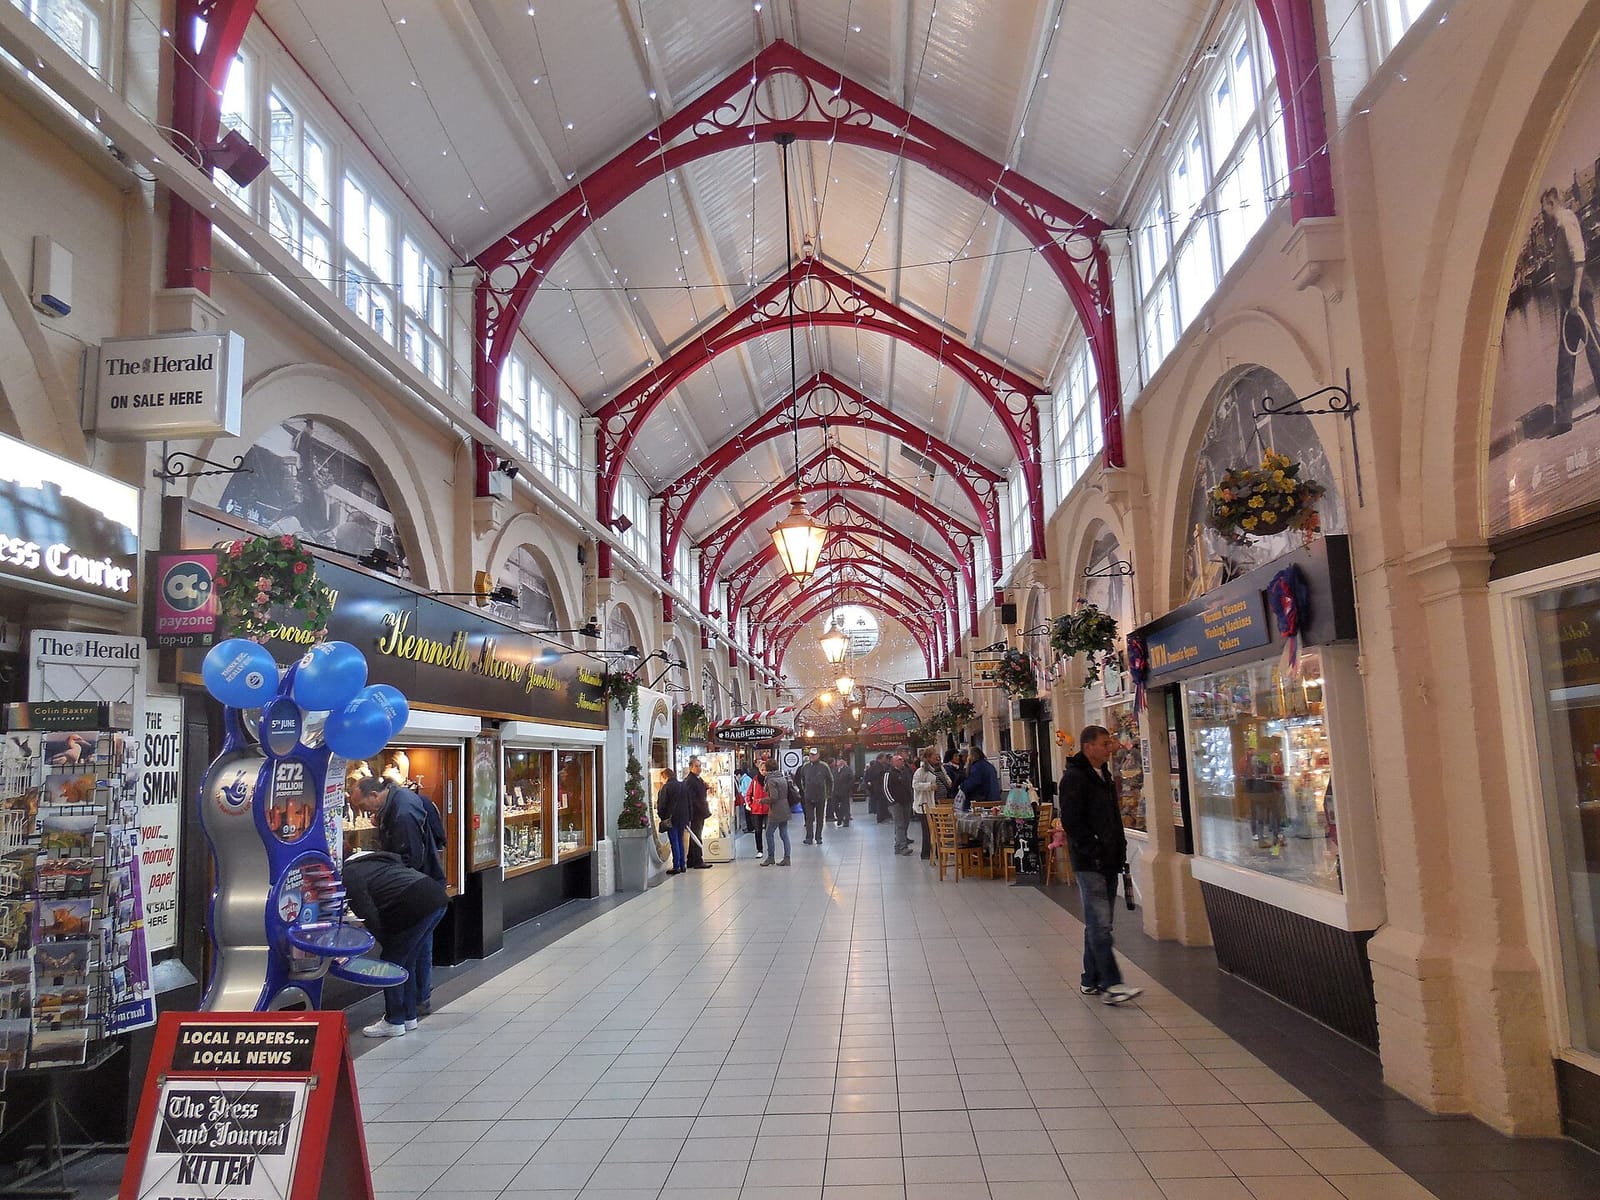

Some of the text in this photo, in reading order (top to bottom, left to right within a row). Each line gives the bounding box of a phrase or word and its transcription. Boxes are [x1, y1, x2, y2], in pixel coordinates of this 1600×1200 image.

[106, 354, 213, 375] The Herald
[111, 391, 203, 409] ON SALE HERE
[45, 543, 132, 592] Courier
[1222, 601, 1247, 615] Cleaners
[160, 616, 213, 629] payzone
[1225, 615, 1252, 632] Machines
[38, 637, 140, 659] The Herald
[160, 636, 194, 646] top-up
[380, 609, 472, 672] Kenneth
[476, 638, 523, 682] Moore
[34, 707, 60, 715] Colin
[145, 712, 162, 729] THE
[281, 719, 296, 729] JUNE
[724, 727, 775, 738] BARBER SHOP
[276, 763, 304, 781] £72
[142, 771, 178, 805] SMAN
[276, 782, 304, 791] MILLION
[141, 825, 161, 844] your
[142, 847, 175, 866] morning
[148, 871, 175, 894] paper
[154, 900, 175, 913] SALE
[183, 1031, 310, 1044] LOCAL PAPERS...
[193, 1051, 292, 1064] LOCAL NEWS
[169, 1095, 259, 1121] The Press
[177, 1121, 284, 1147] and Journal
[177, 1155, 257, 1185] KITTEN
